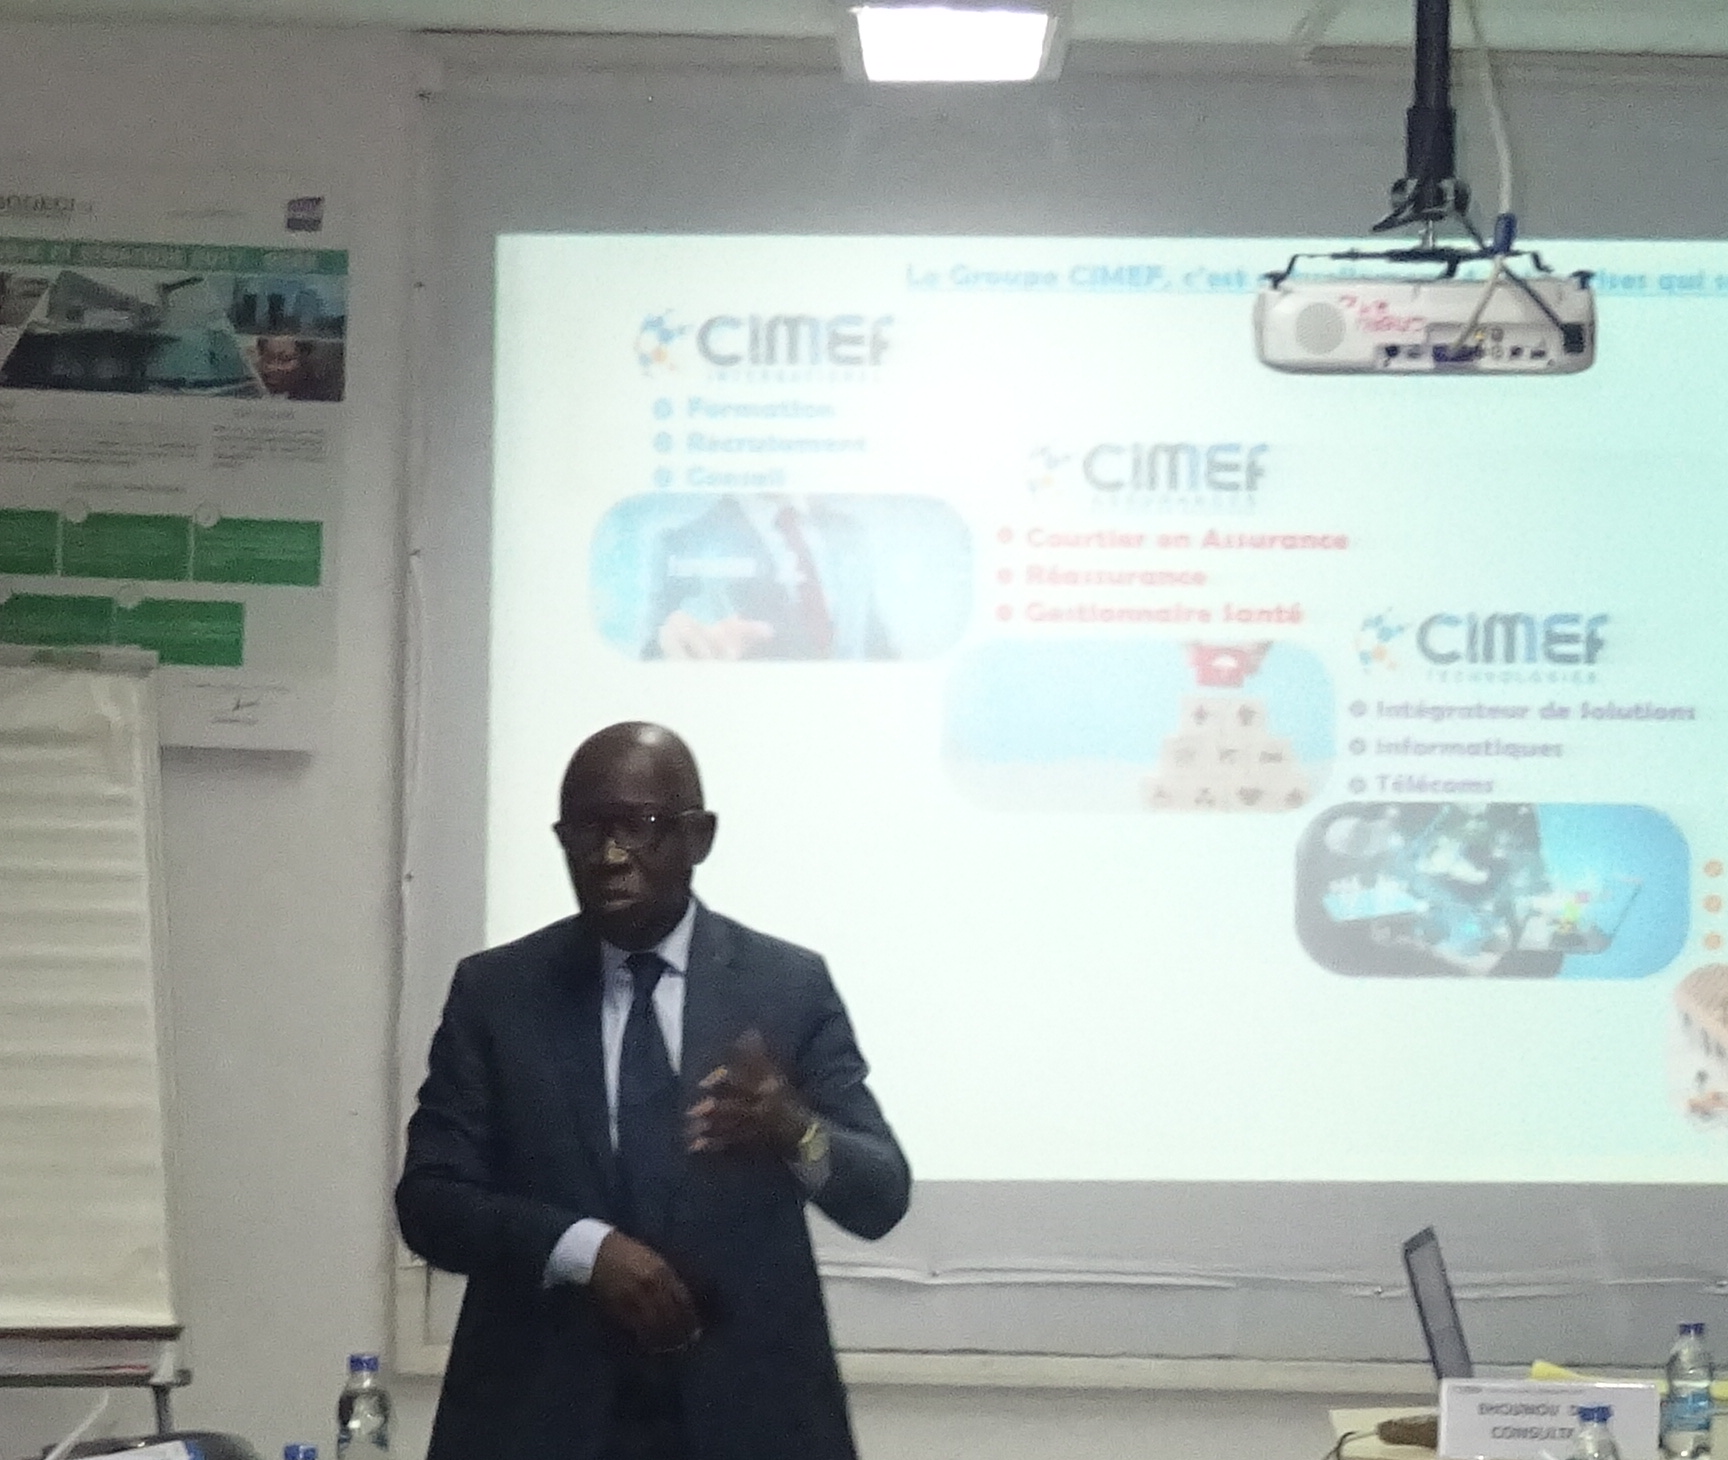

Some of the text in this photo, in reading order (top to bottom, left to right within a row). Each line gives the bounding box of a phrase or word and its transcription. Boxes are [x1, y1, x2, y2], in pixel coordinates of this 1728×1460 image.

[697, 313, 894, 367] CIMEF
[688, 397, 835, 418] Formation
[1082, 442, 1268, 492] CIMEF
[1028, 528, 1144, 549] Courtier
[1201, 527, 1349, 550] Assurance
[1416, 611, 1610, 665] CIMEF
[1376, 700, 1696, 722] Intégrateur de Solutions
[1376, 736, 1563, 759] Informatiques
